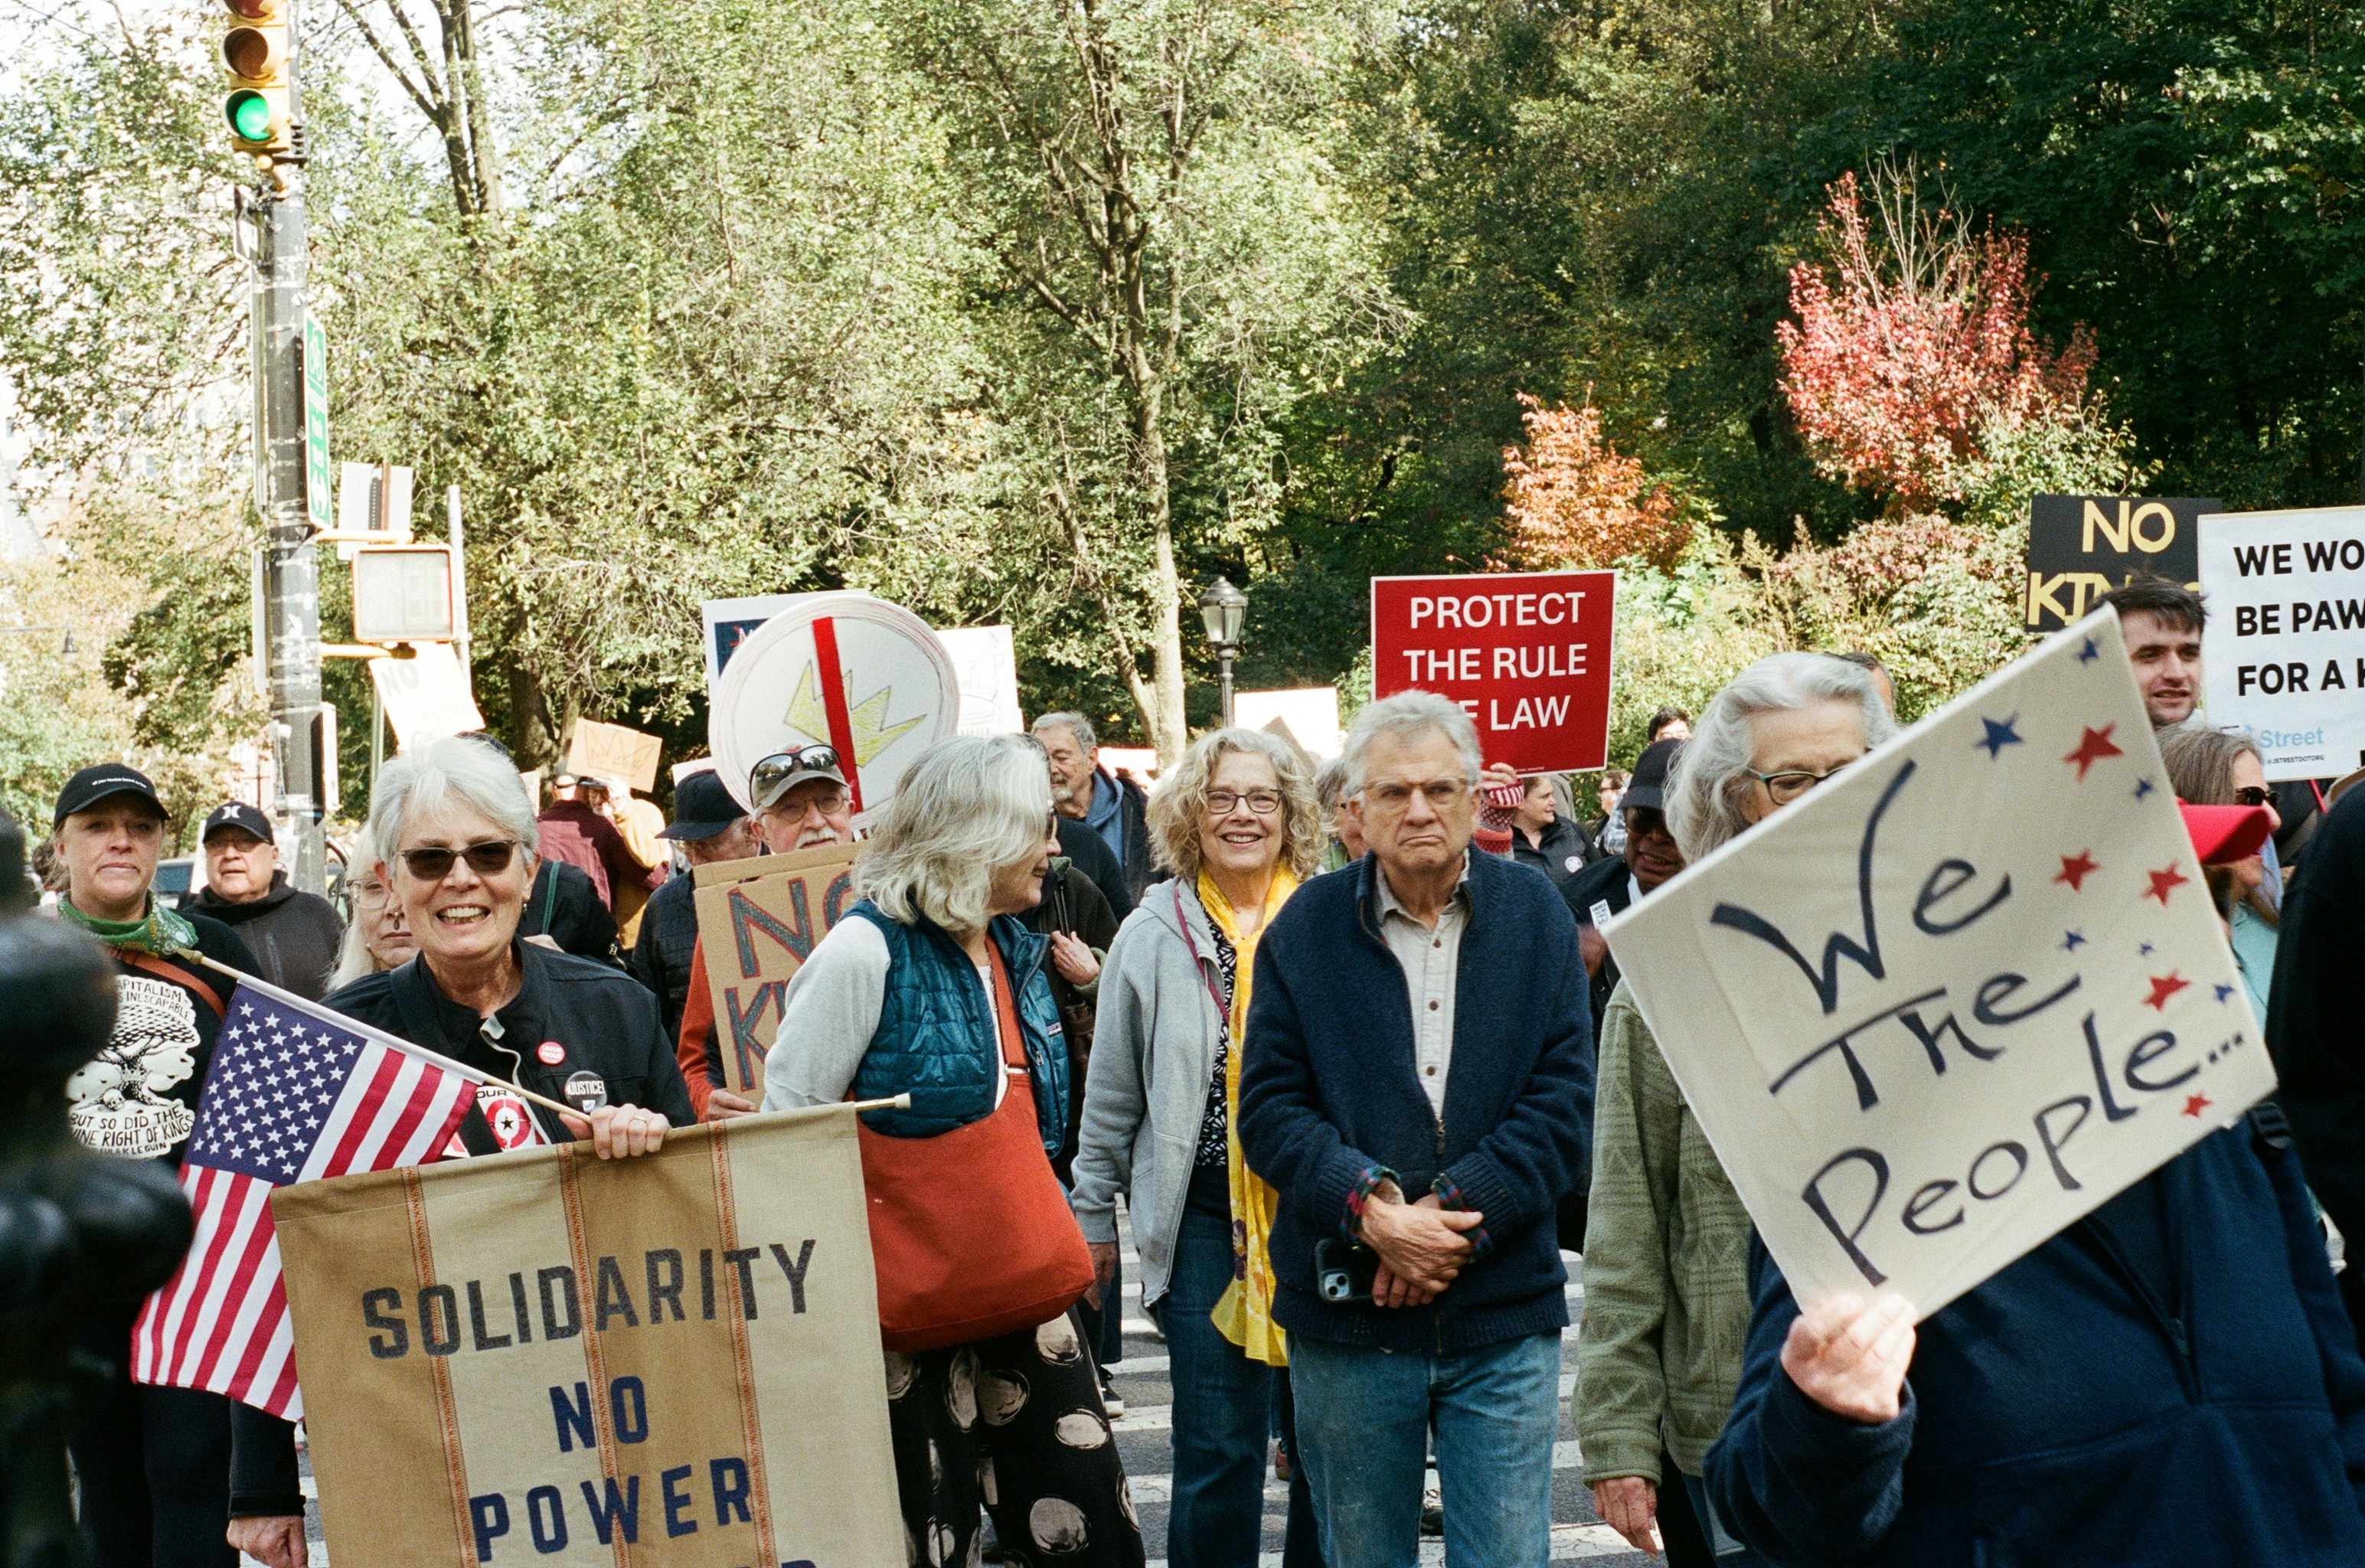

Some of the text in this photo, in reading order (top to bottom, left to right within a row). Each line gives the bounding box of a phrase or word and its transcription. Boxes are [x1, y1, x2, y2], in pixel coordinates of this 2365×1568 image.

[2082, 500, 2175, 554] NO
[2233, 543, 2292, 577] WE
[1410, 591, 1586, 629] PROTECT
[2236, 603, 2280, 637] BE
[1403, 643, 1588, 682] THE RULE
[2238, 662, 2309, 697] FOR
[2320, 659, 2347, 691] A
[1491, 694, 1571, 731] LAW
[2259, 727, 2324, 749] Street
[1711, 758, 2011, 1015] We
[126, 991, 191, 1022] INESCAPABLE
[1769, 972, 2082, 1112] The
[70, 1105, 184, 1130] BUT SO DID THE
[102, 1129, 141, 1148] RIGHT
[146, 1126, 159, 1142] OF
[162, 1115, 194, 1140] KINGS
[361, 1238, 816, 1360] SOLIDARITY
[550, 1375, 648, 1453] NO
[469, 1456, 752, 1563] POWER
